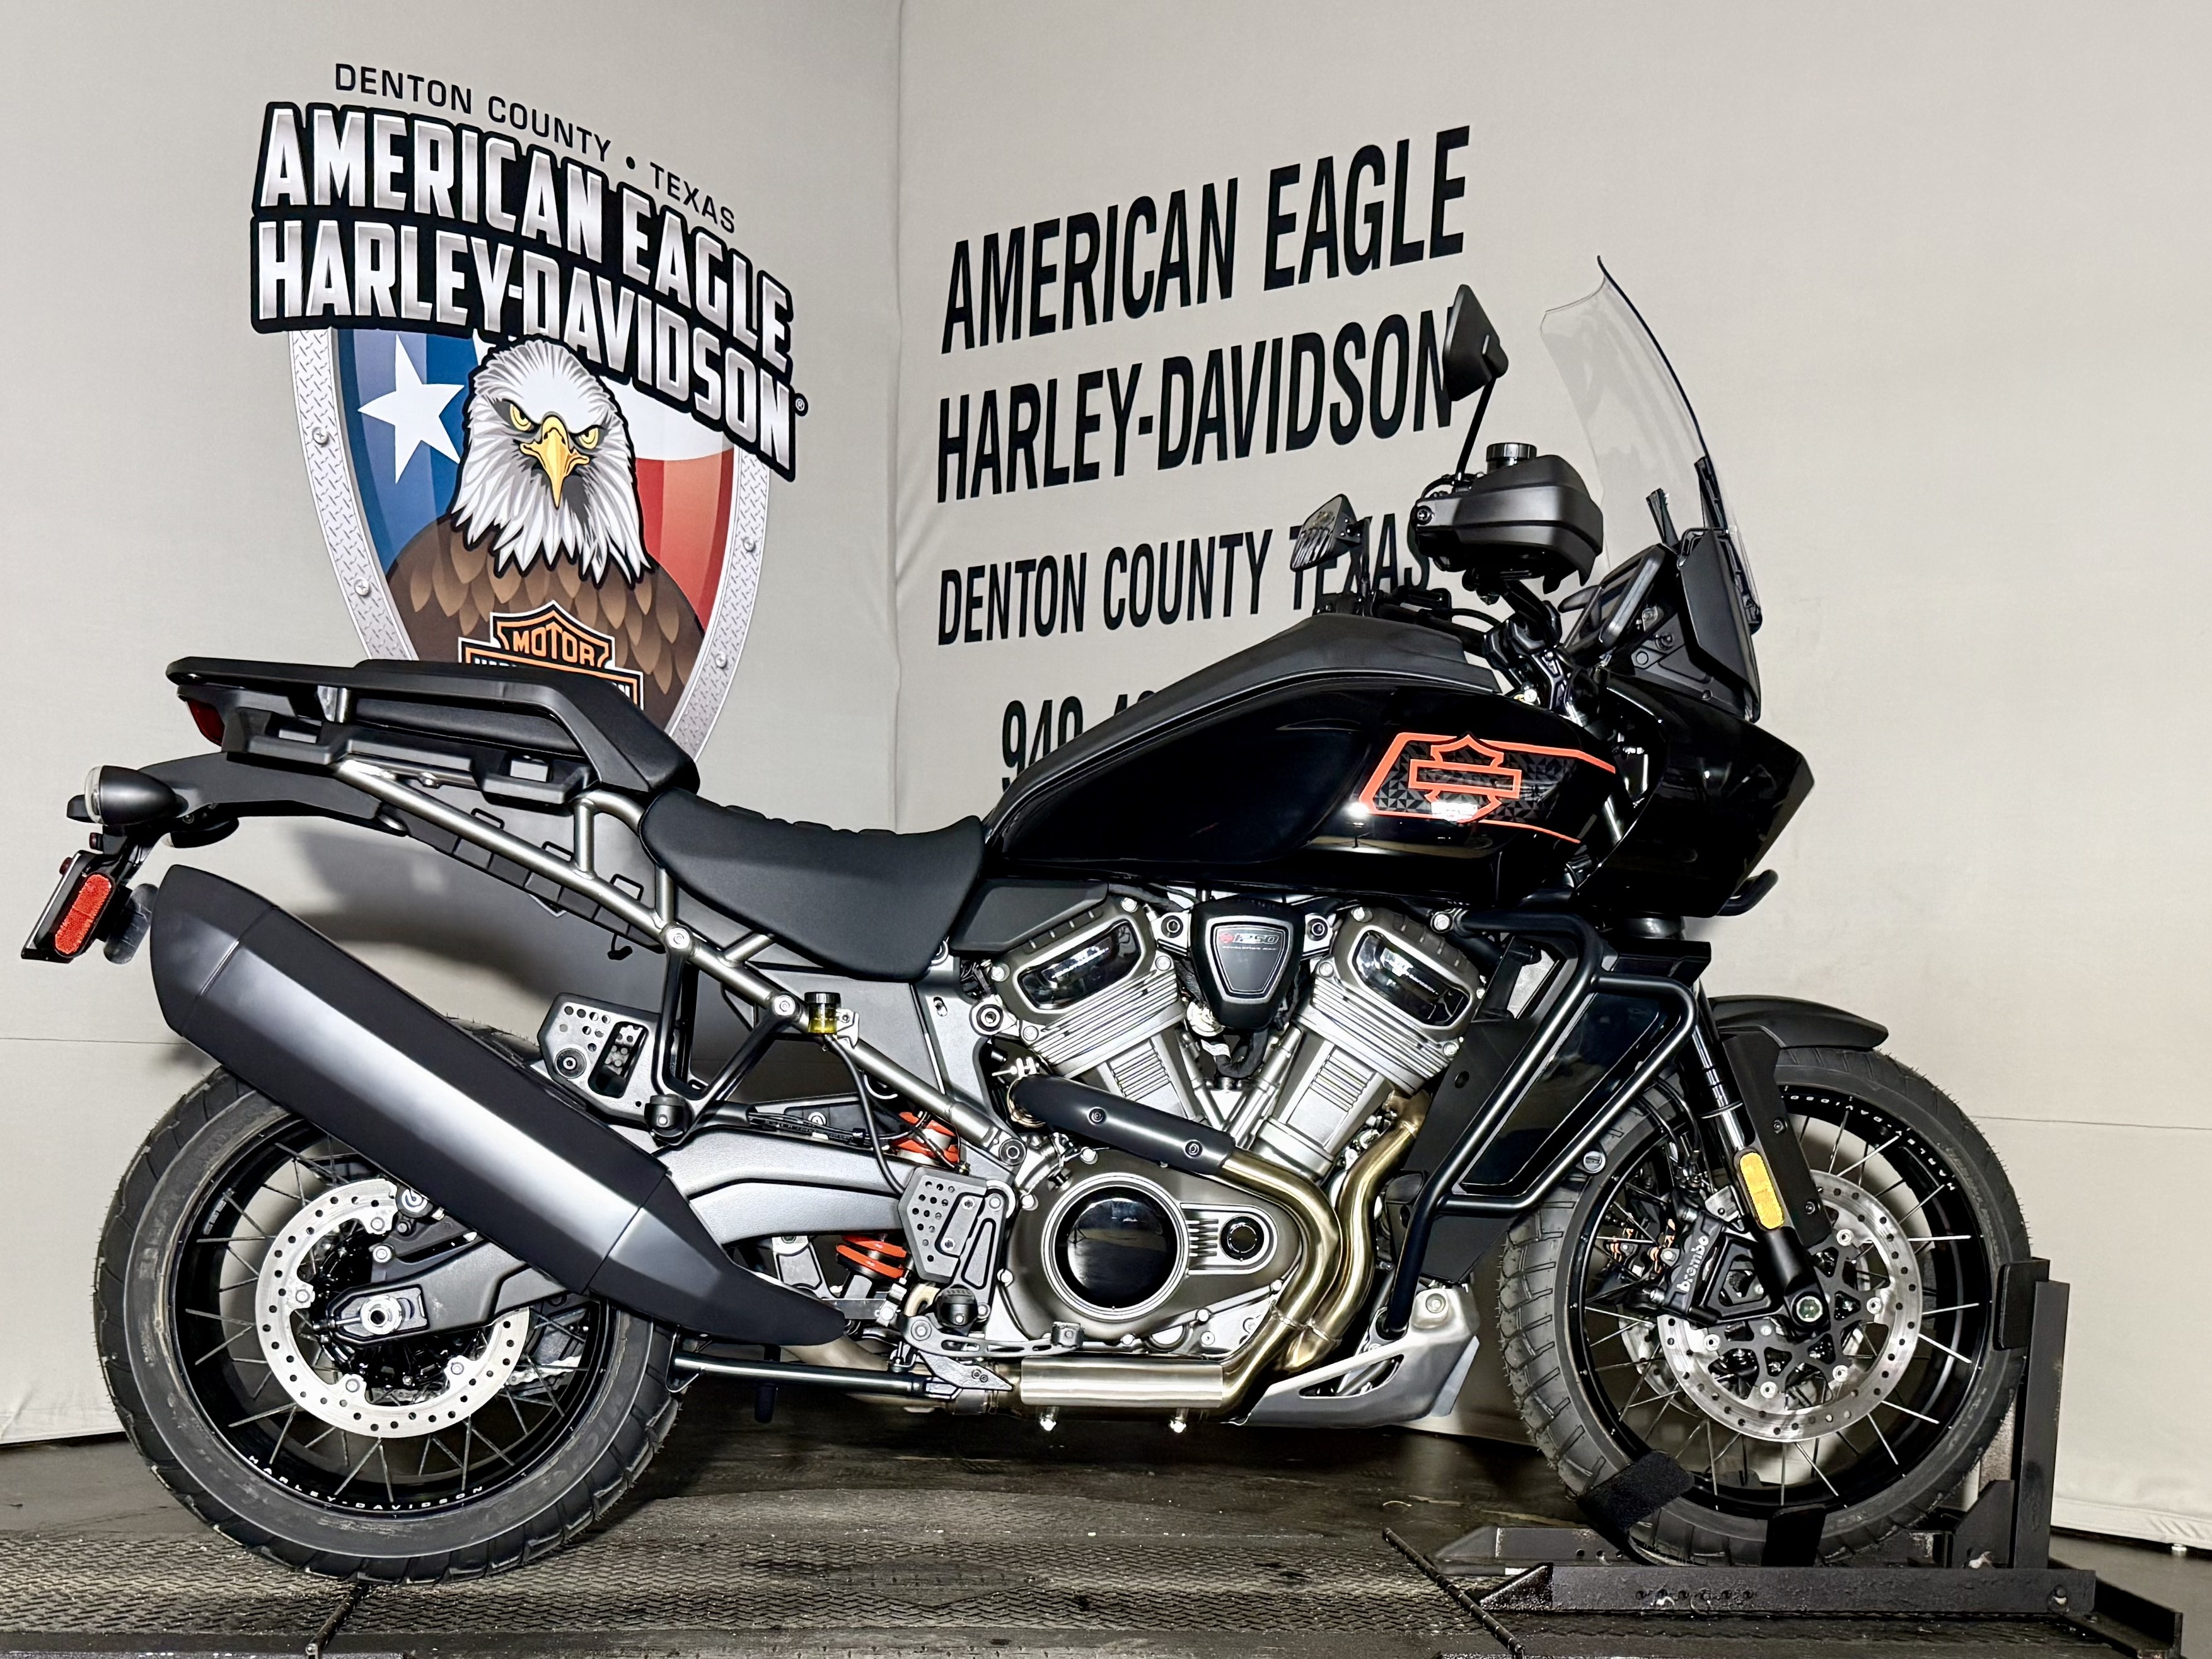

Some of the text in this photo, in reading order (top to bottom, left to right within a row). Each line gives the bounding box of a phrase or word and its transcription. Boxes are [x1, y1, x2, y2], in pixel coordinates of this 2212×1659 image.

[335, 63, 735, 234] DENTON COUNTY TEXAS
[260, 108, 792, 369] AMERICAN EAGLE
[941, 125, 1470, 355] AMERICAN EAGLE
[258, 219, 797, 470] HARLEY-DAVIDSON
[937, 305, 1455, 504] HARLEY-DAVIDSON
[512, 620, 594, 666] MOTOR
[938, 552, 1087, 646] DENTON
[1103, 528, 1274, 631] COUNTY
[1781, 1095, 1955, 1191] HARLEY-DAVIDSO
[1677, 1235, 1709, 1292] brembo
[249, 1455, 483, 1510] HARLEY-DAVIDSON
